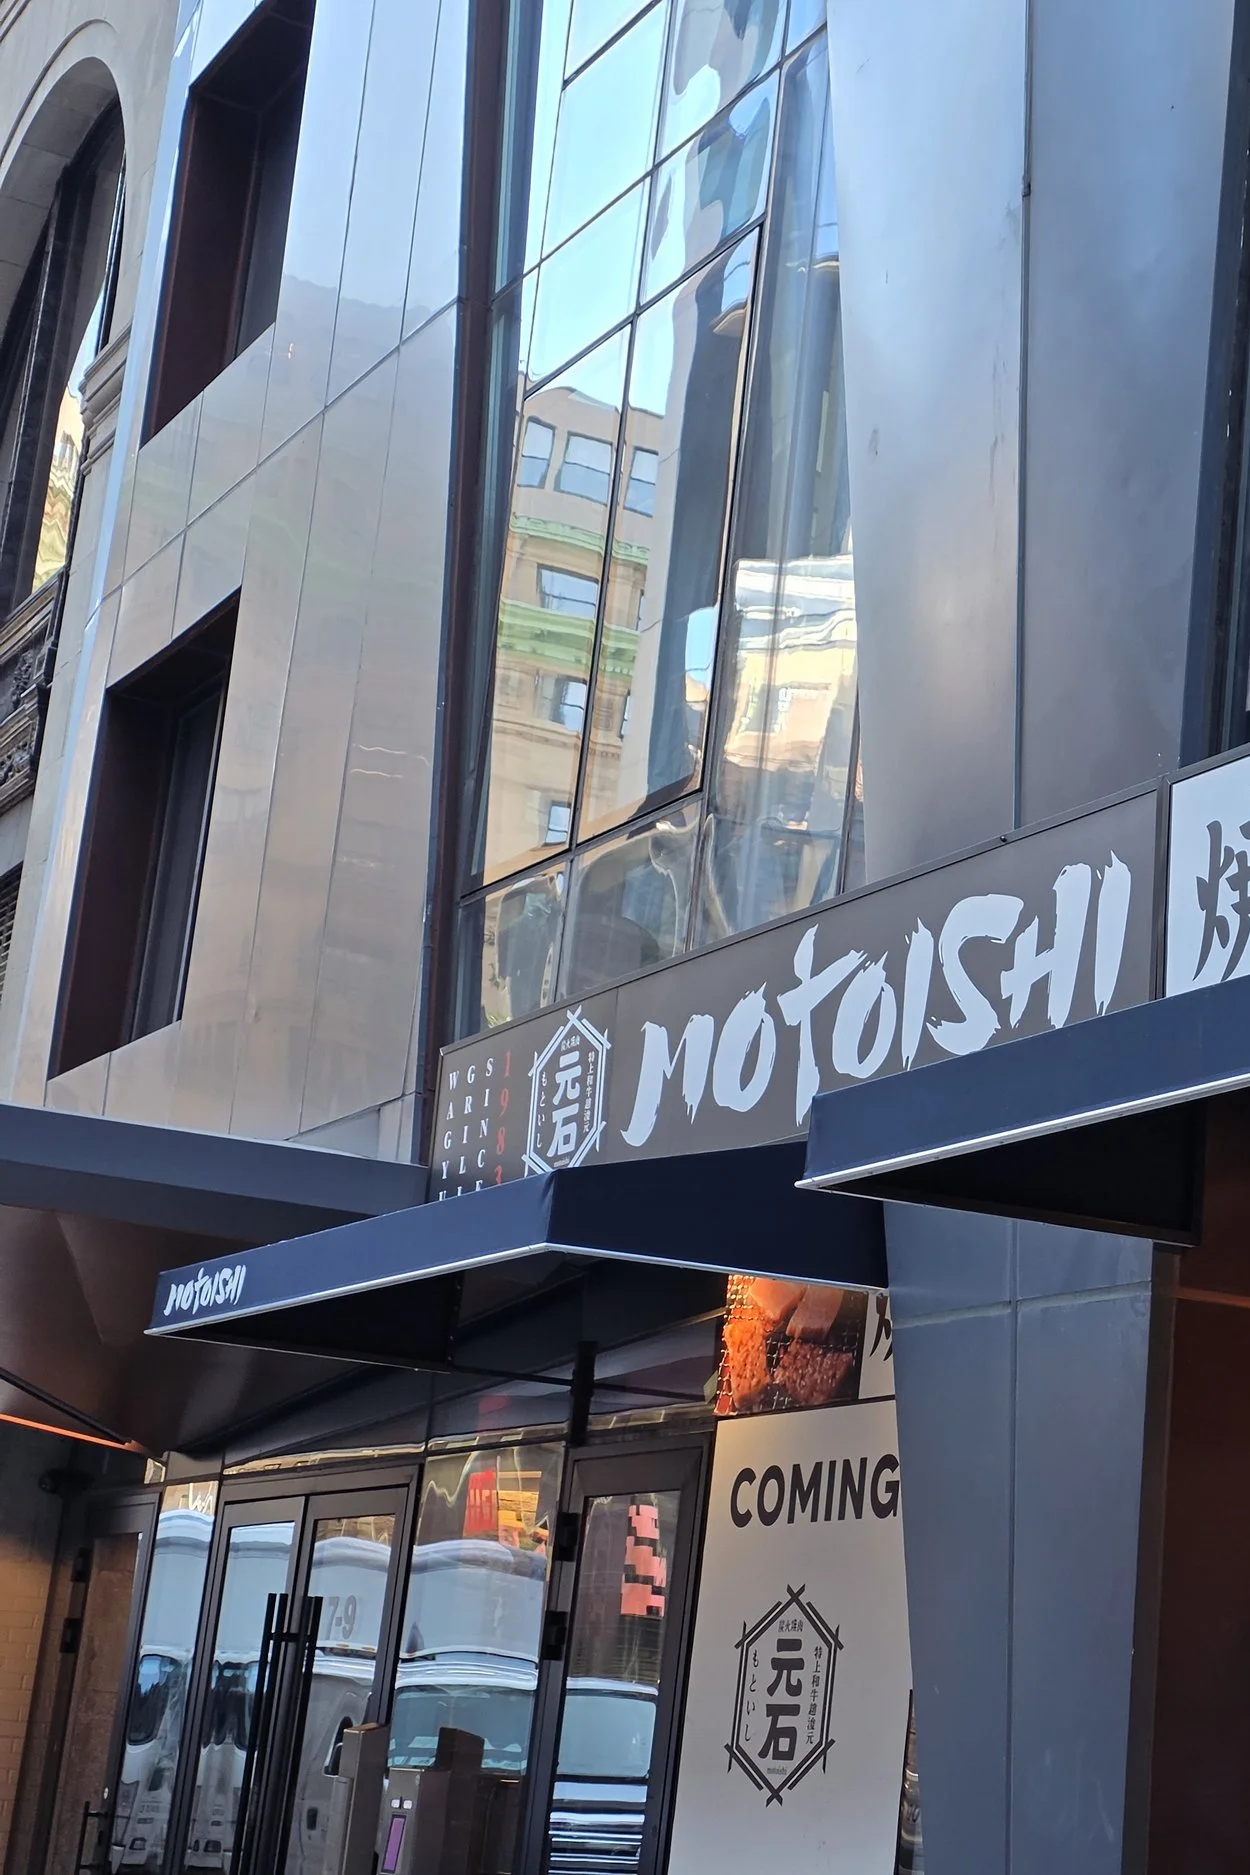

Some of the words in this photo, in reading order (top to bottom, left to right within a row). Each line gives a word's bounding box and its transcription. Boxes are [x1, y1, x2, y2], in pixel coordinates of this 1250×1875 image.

[546, 1050, 582, 1157] 元石
[730, 1453, 900, 1529] COMING
[745, 1649, 759, 1741] もといし
[757, 1638, 805, 1760] 元石
